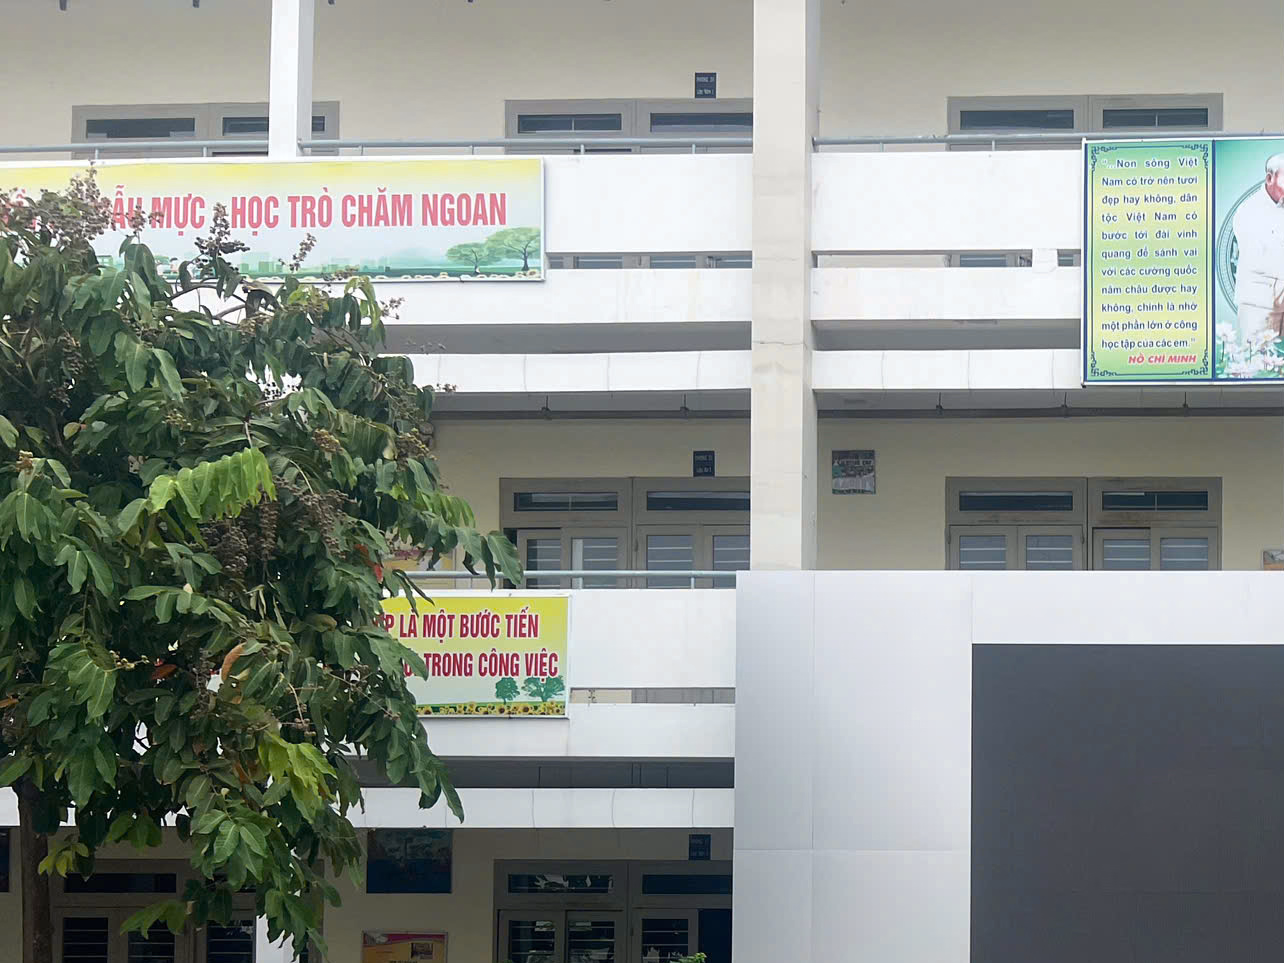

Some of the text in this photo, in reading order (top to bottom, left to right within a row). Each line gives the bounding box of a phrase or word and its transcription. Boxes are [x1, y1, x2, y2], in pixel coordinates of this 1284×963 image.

[1145, 158, 1170, 171] sông
[1178, 158, 1198, 167] Việt
[1101, 176, 1198, 186] Nam có trở nên tươi
[1101, 195, 1120, 206] đẹp
[1123, 194, 1140, 206] hay
[1179, 193, 1198, 202] dân
[151, 193, 206, 237] MỰC
[231, 195, 279, 236] HỌC
[288, 187, 333, 228] TRÒ
[341, 187, 413, 228] CHĂM
[422, 192, 507, 227] NGOAN
[1101, 211, 1198, 224] tộc Việt Nam có
[1101, 229, 1198, 240] bước tới đài vinh
[1101, 246, 1198, 260] quang để sánh vai
[1101, 264, 1197, 277] với các cường quốc
[1101, 284, 1198, 295] năm châu được hay
[1137, 302, 1164, 312] chính
[1166, 302, 1175, 311] là
[1178, 301, 1198, 311] nhờ
[1101, 319, 1198, 332] một phần lớn ở công
[1101, 339, 1120, 350] học
[1120, 339, 1136, 350] tập
[1136, 339, 1154, 348] của
[1155, 338, 1173, 348] các
[1128, 353, 1197, 364] HỒ CHÍ MINH
[400, 608, 418, 638] LÀ
[422, 609, 456, 643] MỘT
[460, 608, 501, 638] BƯỚC
[505, 606, 539, 638] TIẾN
[424, 652, 474, 677] TRONG
[479, 648, 520, 677] CÔNG
[525, 648, 559, 683] VIỆC
